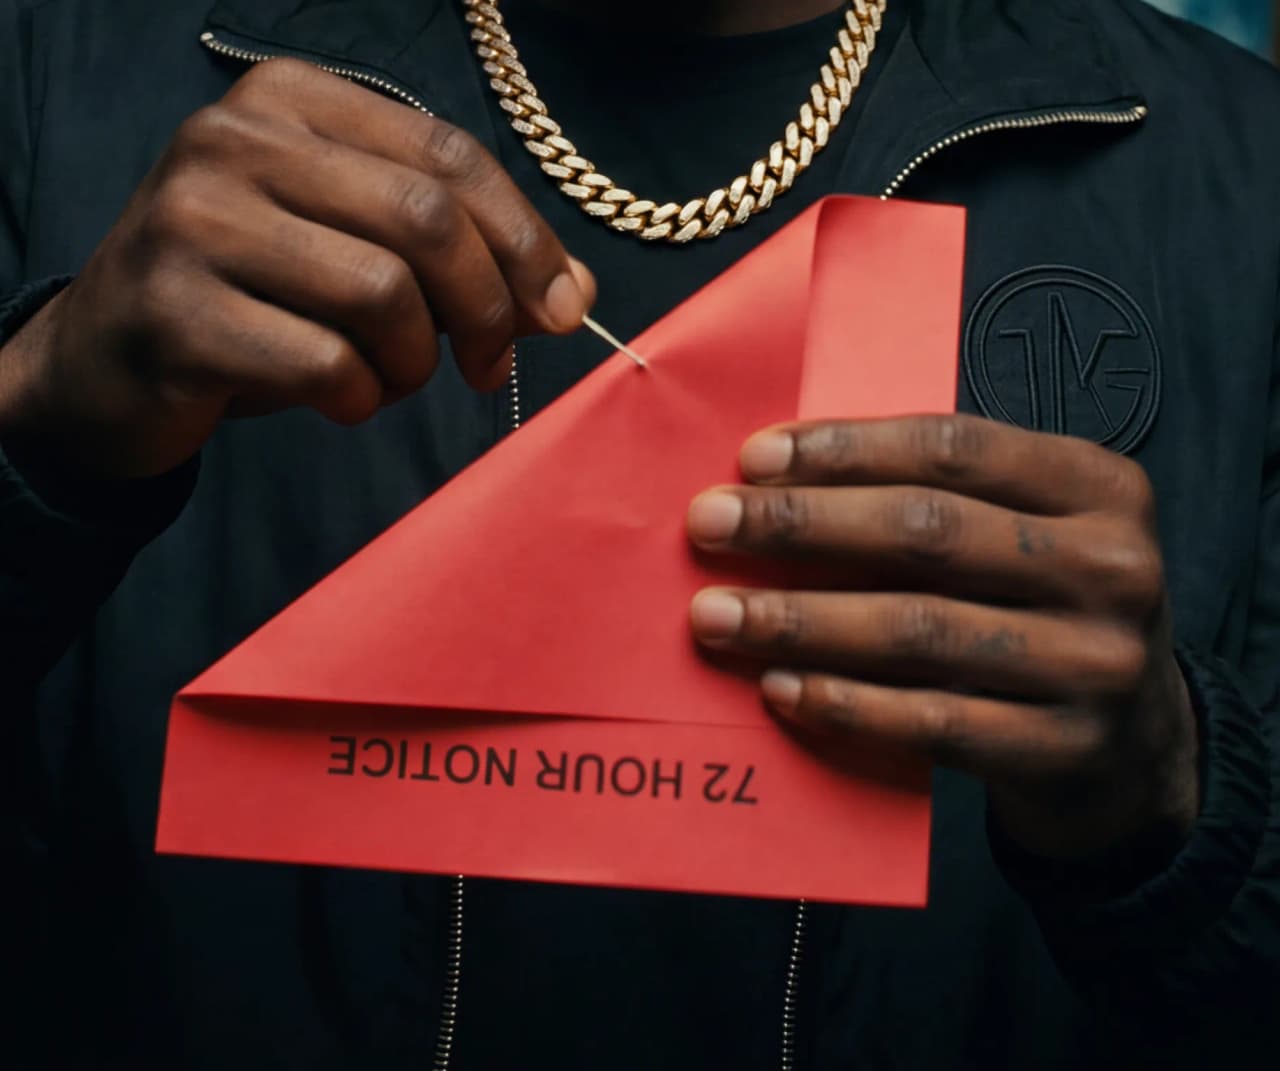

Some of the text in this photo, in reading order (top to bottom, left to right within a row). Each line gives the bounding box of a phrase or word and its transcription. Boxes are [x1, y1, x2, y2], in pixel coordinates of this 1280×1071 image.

[327, 734, 759, 805] 72 HOUR NOTICE
